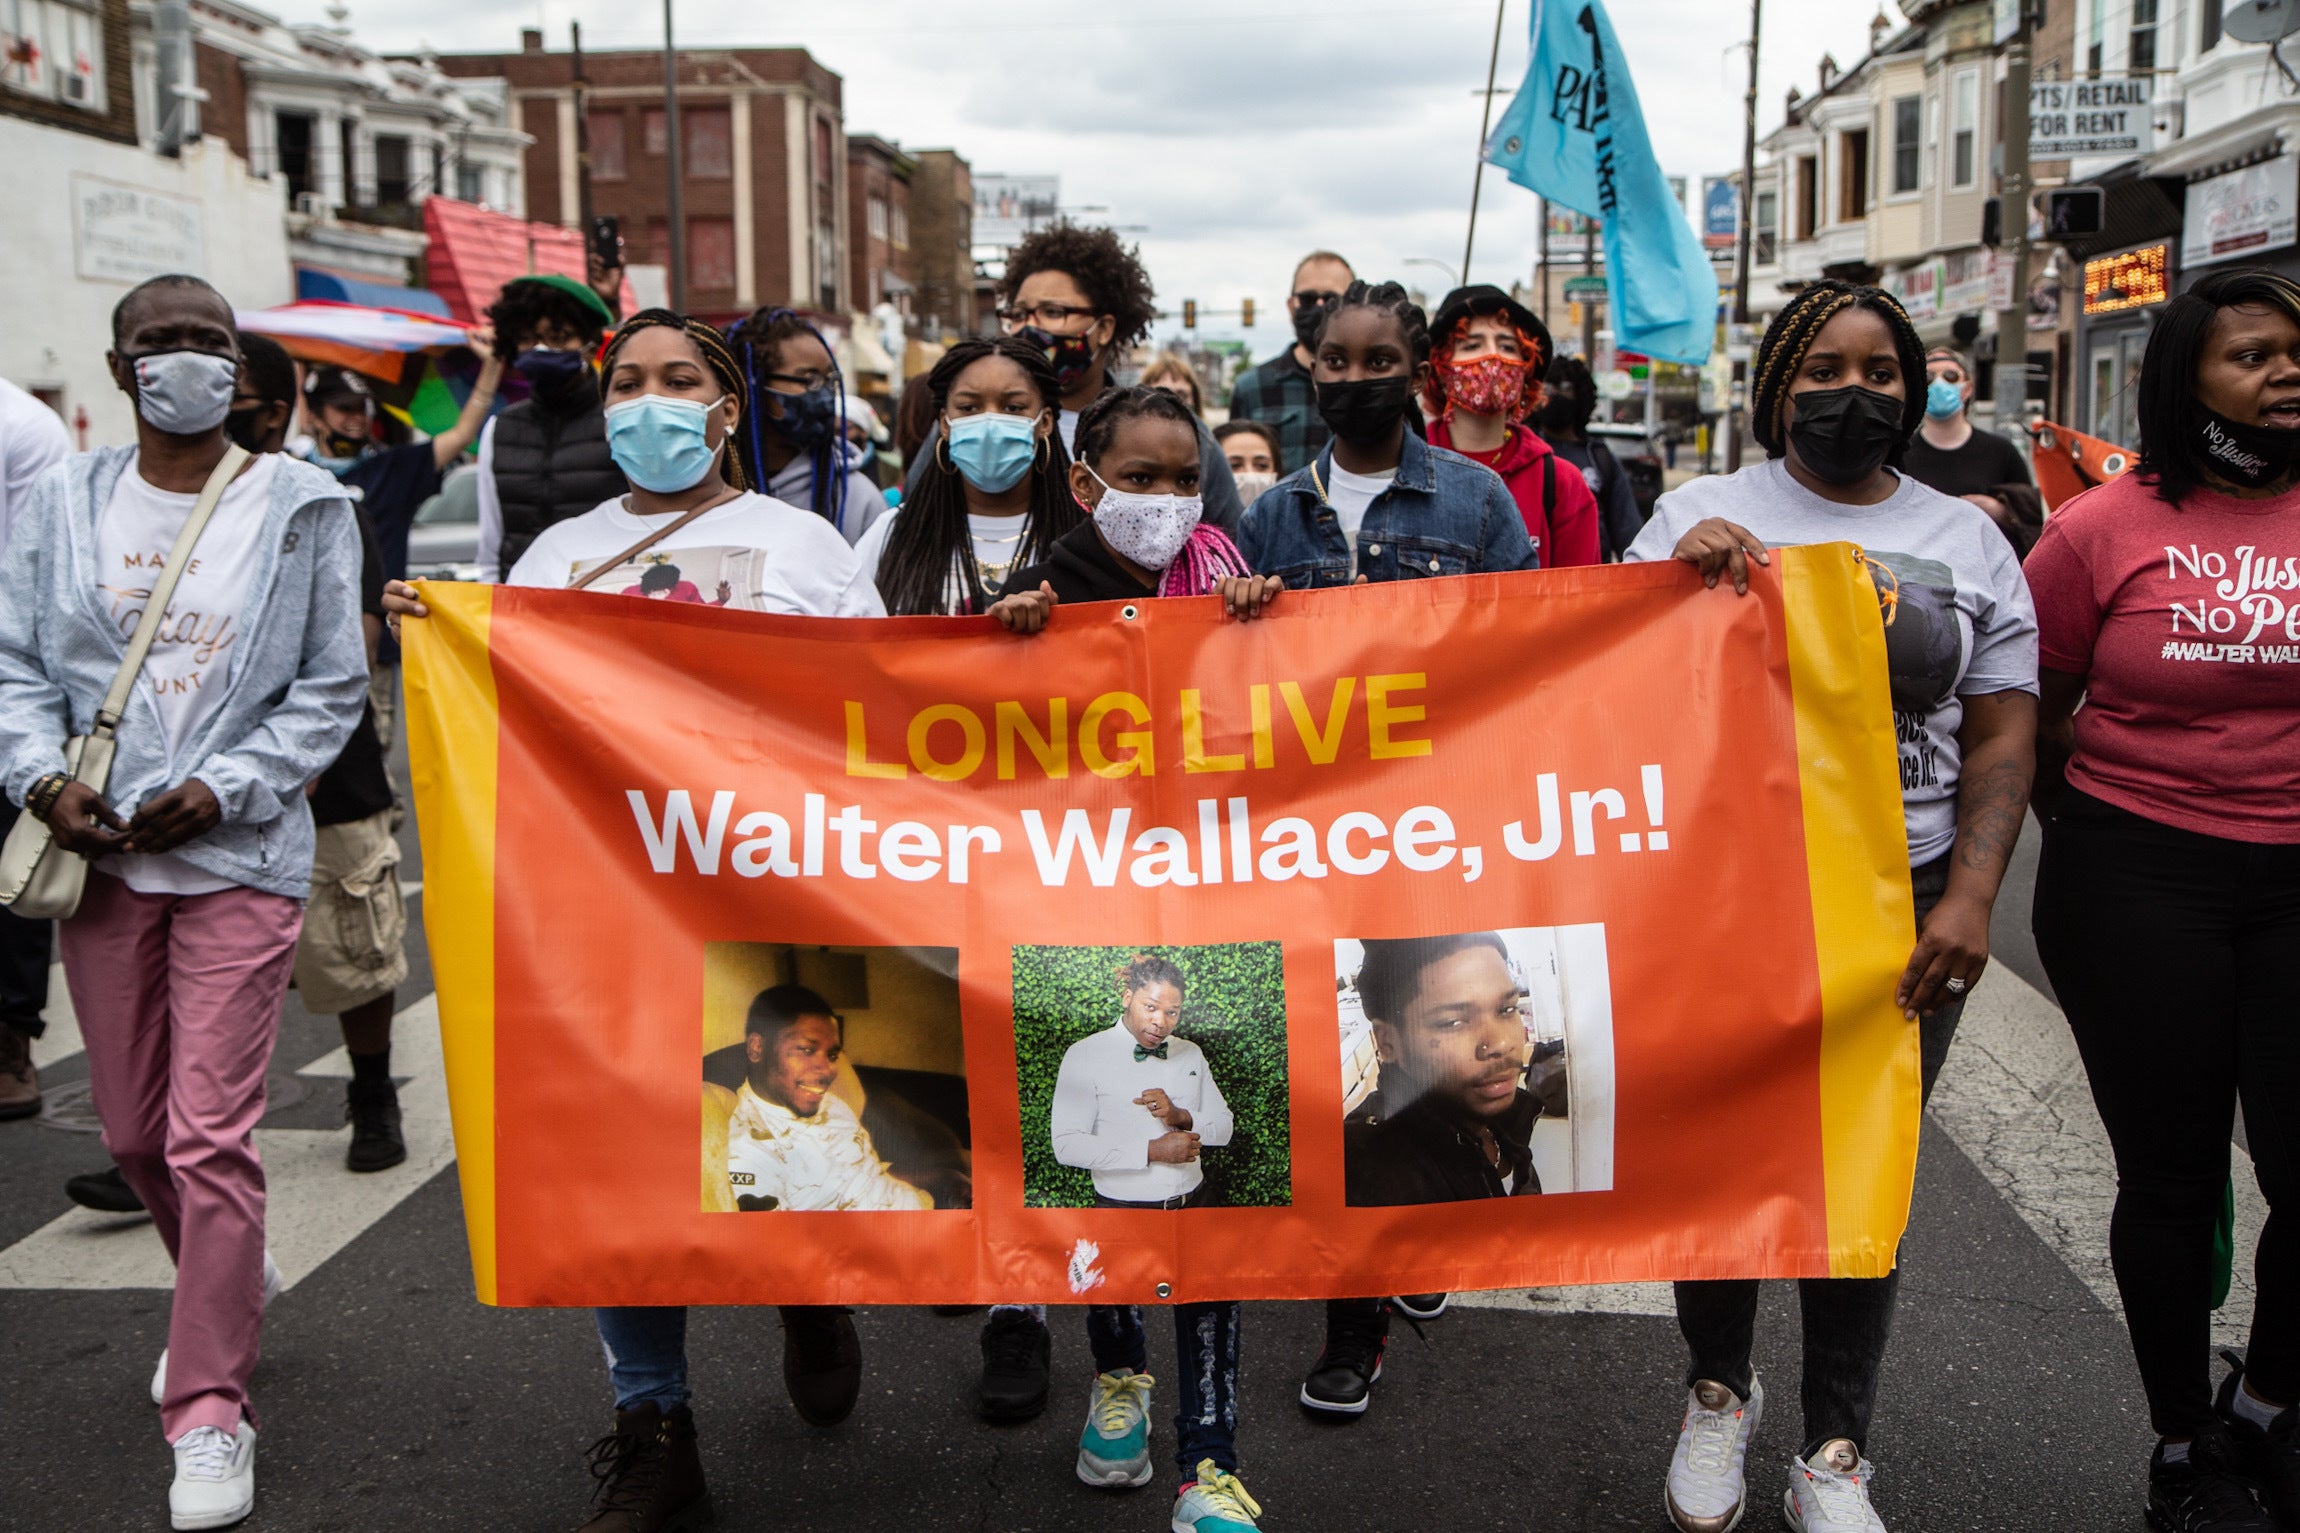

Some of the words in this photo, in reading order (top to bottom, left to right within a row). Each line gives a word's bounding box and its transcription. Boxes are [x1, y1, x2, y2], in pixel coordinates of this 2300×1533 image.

[2076, 111, 2127, 134] RENT
[2202, 420, 2225, 445] No
[123, 552, 202, 576] MAE
[2163, 543, 2228, 580] No
[2215, 545, 2300, 602] Jus
[2168, 599, 2237, 634] No
[2160, 641, 2256, 664] #WALTER
[843, 692, 1156, 782] LONG
[1180, 671, 1434, 774] LIVE
[1895, 710, 1929, 745] ace
[1898, 754, 1919, 791] ce
[625, 789, 1003, 886] Walter
[1020, 796, 1485, 890] Wallace,
[1502, 764, 1671, 863] Jr.!
